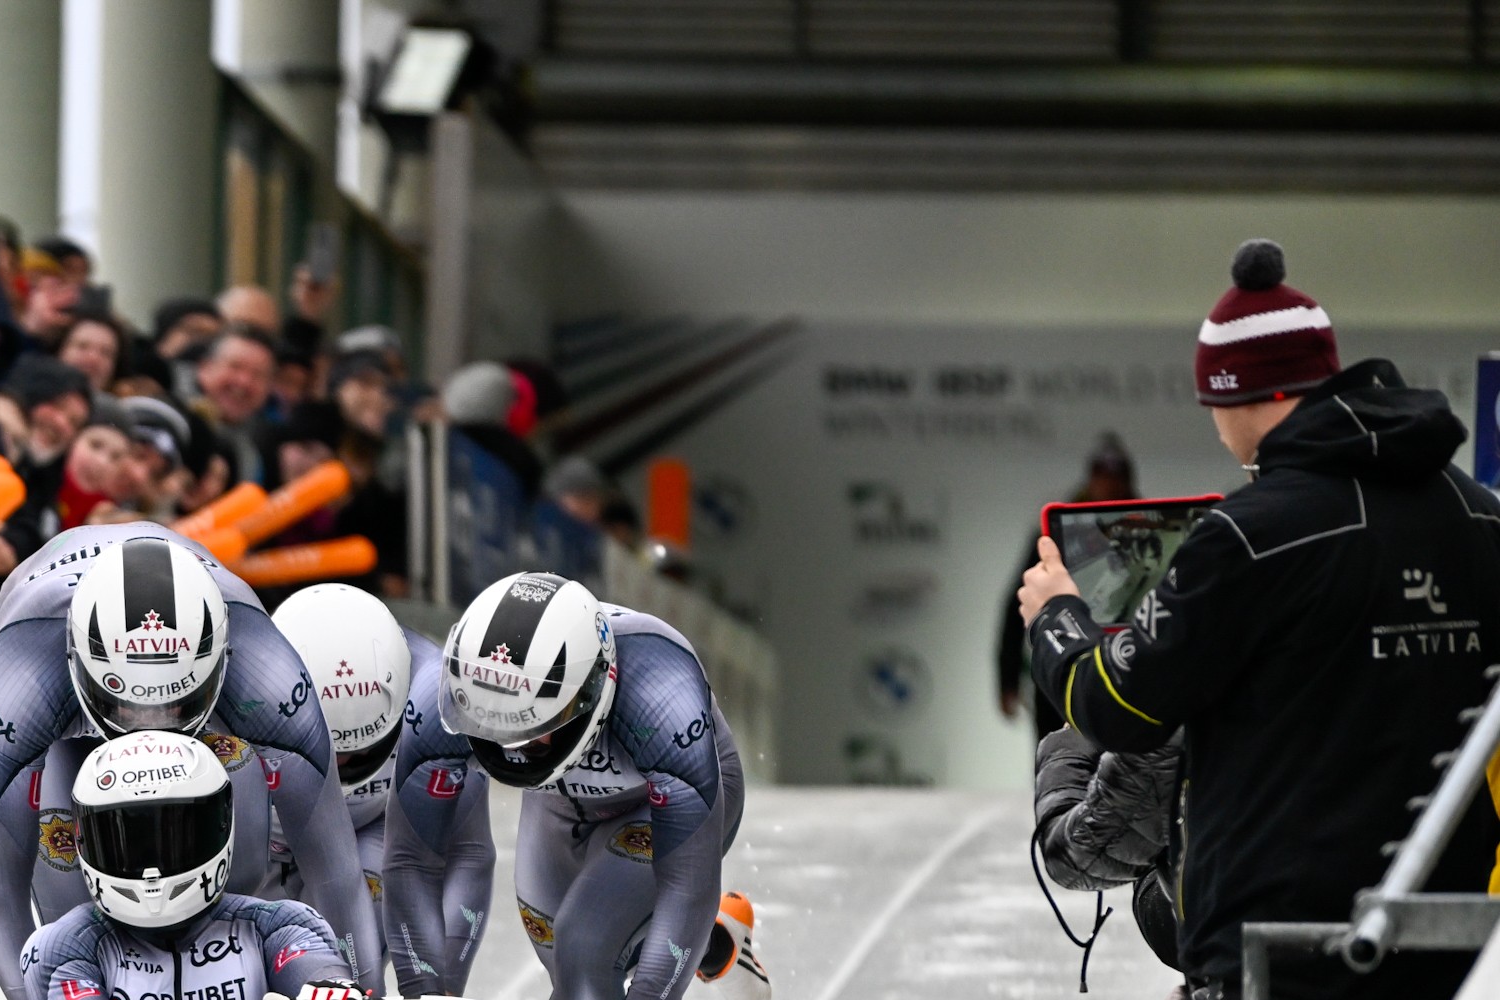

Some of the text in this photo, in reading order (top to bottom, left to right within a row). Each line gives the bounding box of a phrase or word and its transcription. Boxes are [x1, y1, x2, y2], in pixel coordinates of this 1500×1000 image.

[114, 637, 190, 655] LATVIJA
[1372, 632, 1481, 659] LATVIA
[131, 671, 198, 698] OPTIBET
[320, 680, 382, 700] ATVIJA
[463, 662, 532, 693] LATVIJA
[278, 670, 313, 718] tet
[331, 713, 388, 741] OPTIBET
[404, 699, 424, 736] et
[474, 706, 538, 725] OPTIBET
[672, 709, 710, 749] tet
[109, 745, 184, 762] LATVIJA
[578, 749, 622, 775] et
[122, 764, 188, 784] OPTIBET
[190, 934, 243, 968] tet
[118, 957, 164, 975] ATVIJA
